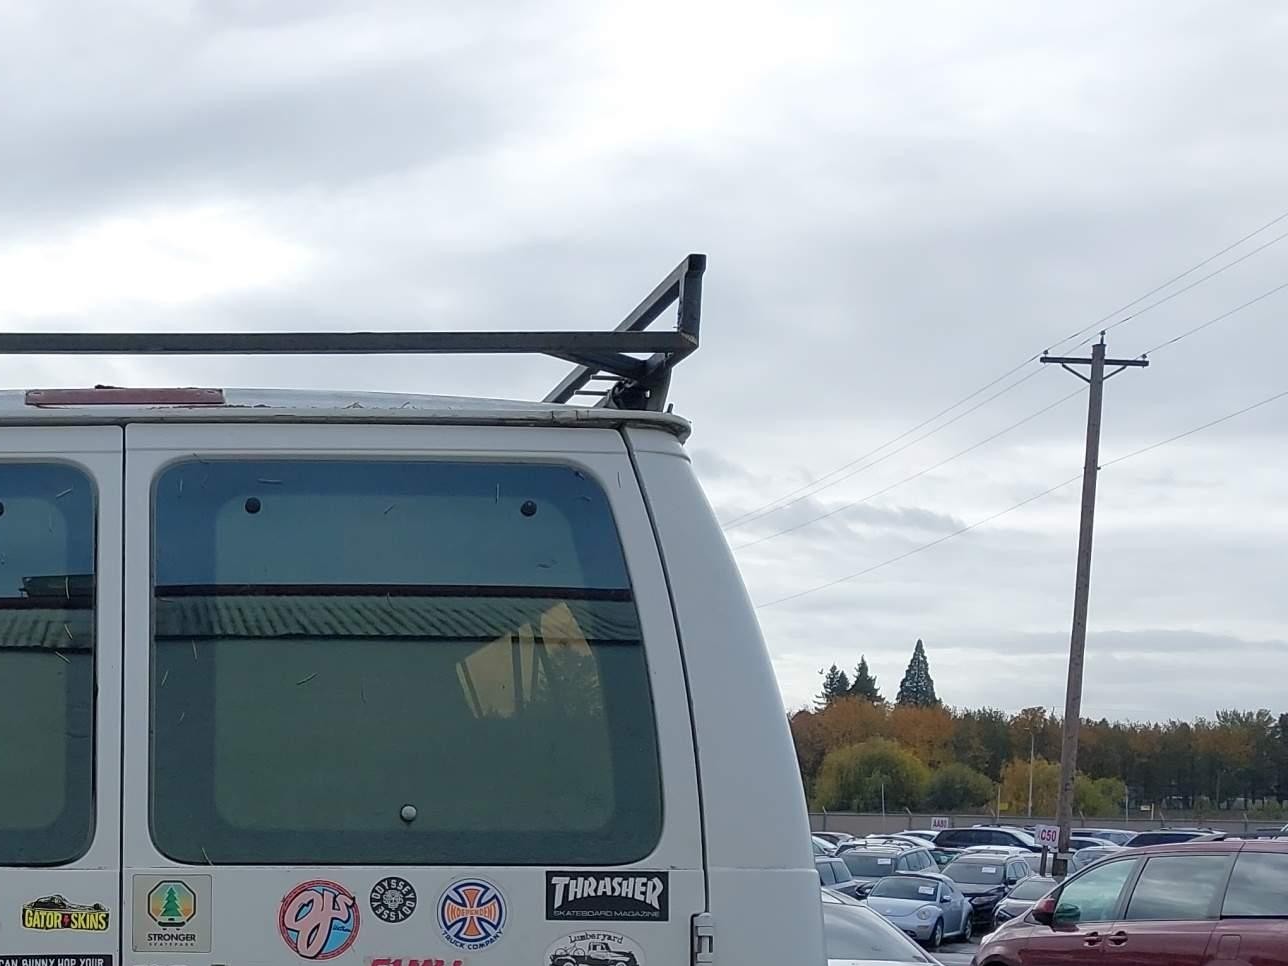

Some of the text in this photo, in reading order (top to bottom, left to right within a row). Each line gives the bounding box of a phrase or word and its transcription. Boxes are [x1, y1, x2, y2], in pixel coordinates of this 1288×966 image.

[372, 880, 415, 921] ODYSSEY ODYSSEY
[551, 876, 663, 910] THRASHER
[25, 909, 106, 929] GATOR SKINS
[147, 933, 197, 942] STRONGER
[442, 929, 503, 950] TRUCK COMPANY
[569, 932, 623, 944] Lumberyard
